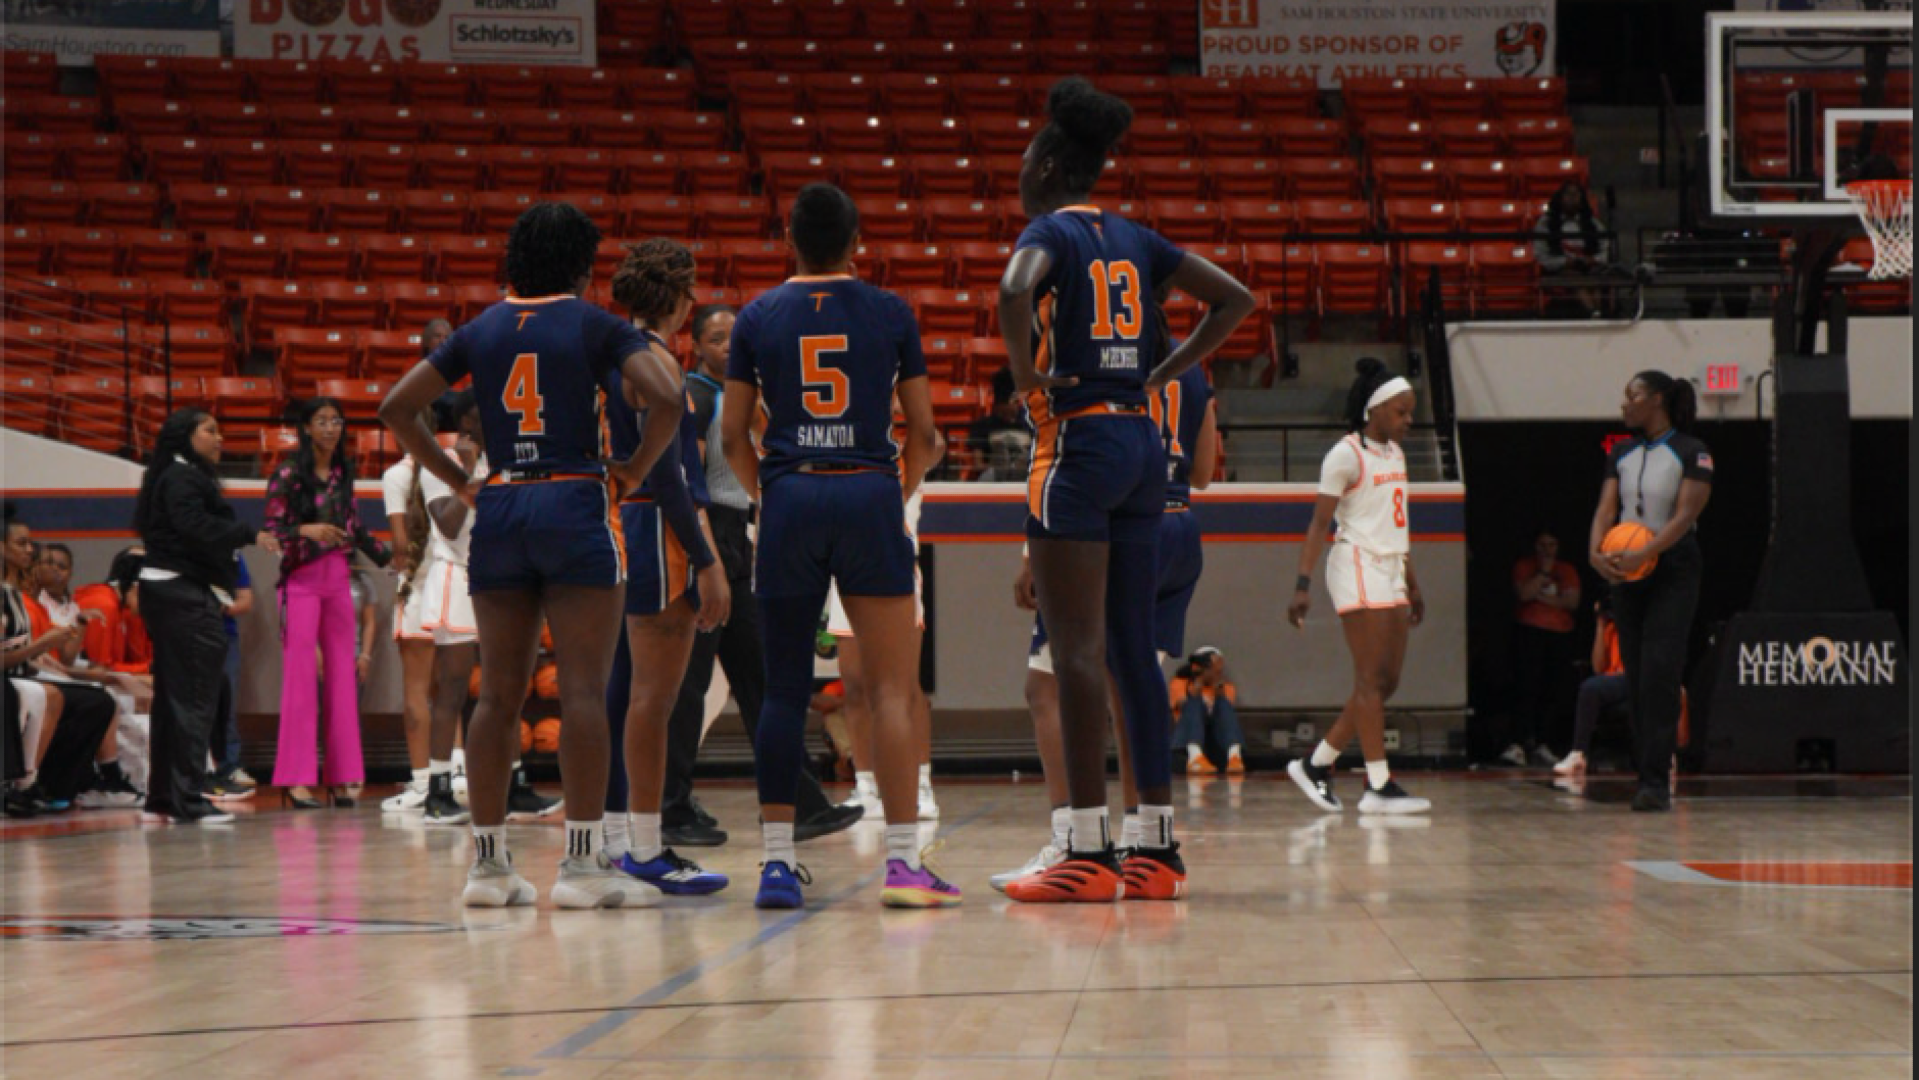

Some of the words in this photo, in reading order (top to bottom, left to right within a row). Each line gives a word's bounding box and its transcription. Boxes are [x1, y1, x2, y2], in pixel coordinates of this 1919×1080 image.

[1281, 7, 1313, 20] SAM
[1318, 6, 1396, 19] HOUSTON
[1402, 6, 1446, 19] STATE
[1452, 5, 1547, 18] UNIVERSITY
[271, 33, 421, 63] PIZZAS
[457, 24, 575, 47] Schlotzsky's
[1204, 35, 1290, 54] PROUD
[1298, 35, 1419, 54] SPONSOR
[1429, 35, 1463, 53] OF
[1207, 64, 1322, 79] BEARKAT
[1330, 64, 1466, 82] ATHLETICS
[1088, 259, 1143, 340] 13
[799, 334, 850, 419] 5
[1706, 364, 1739, 389] EXIT
[502, 353, 546, 436] 4
[1393, 487, 1406, 529] 8
[1738, 633, 1897, 666] MEMORIAL
[1738, 660, 1898, 687] HERMANN
